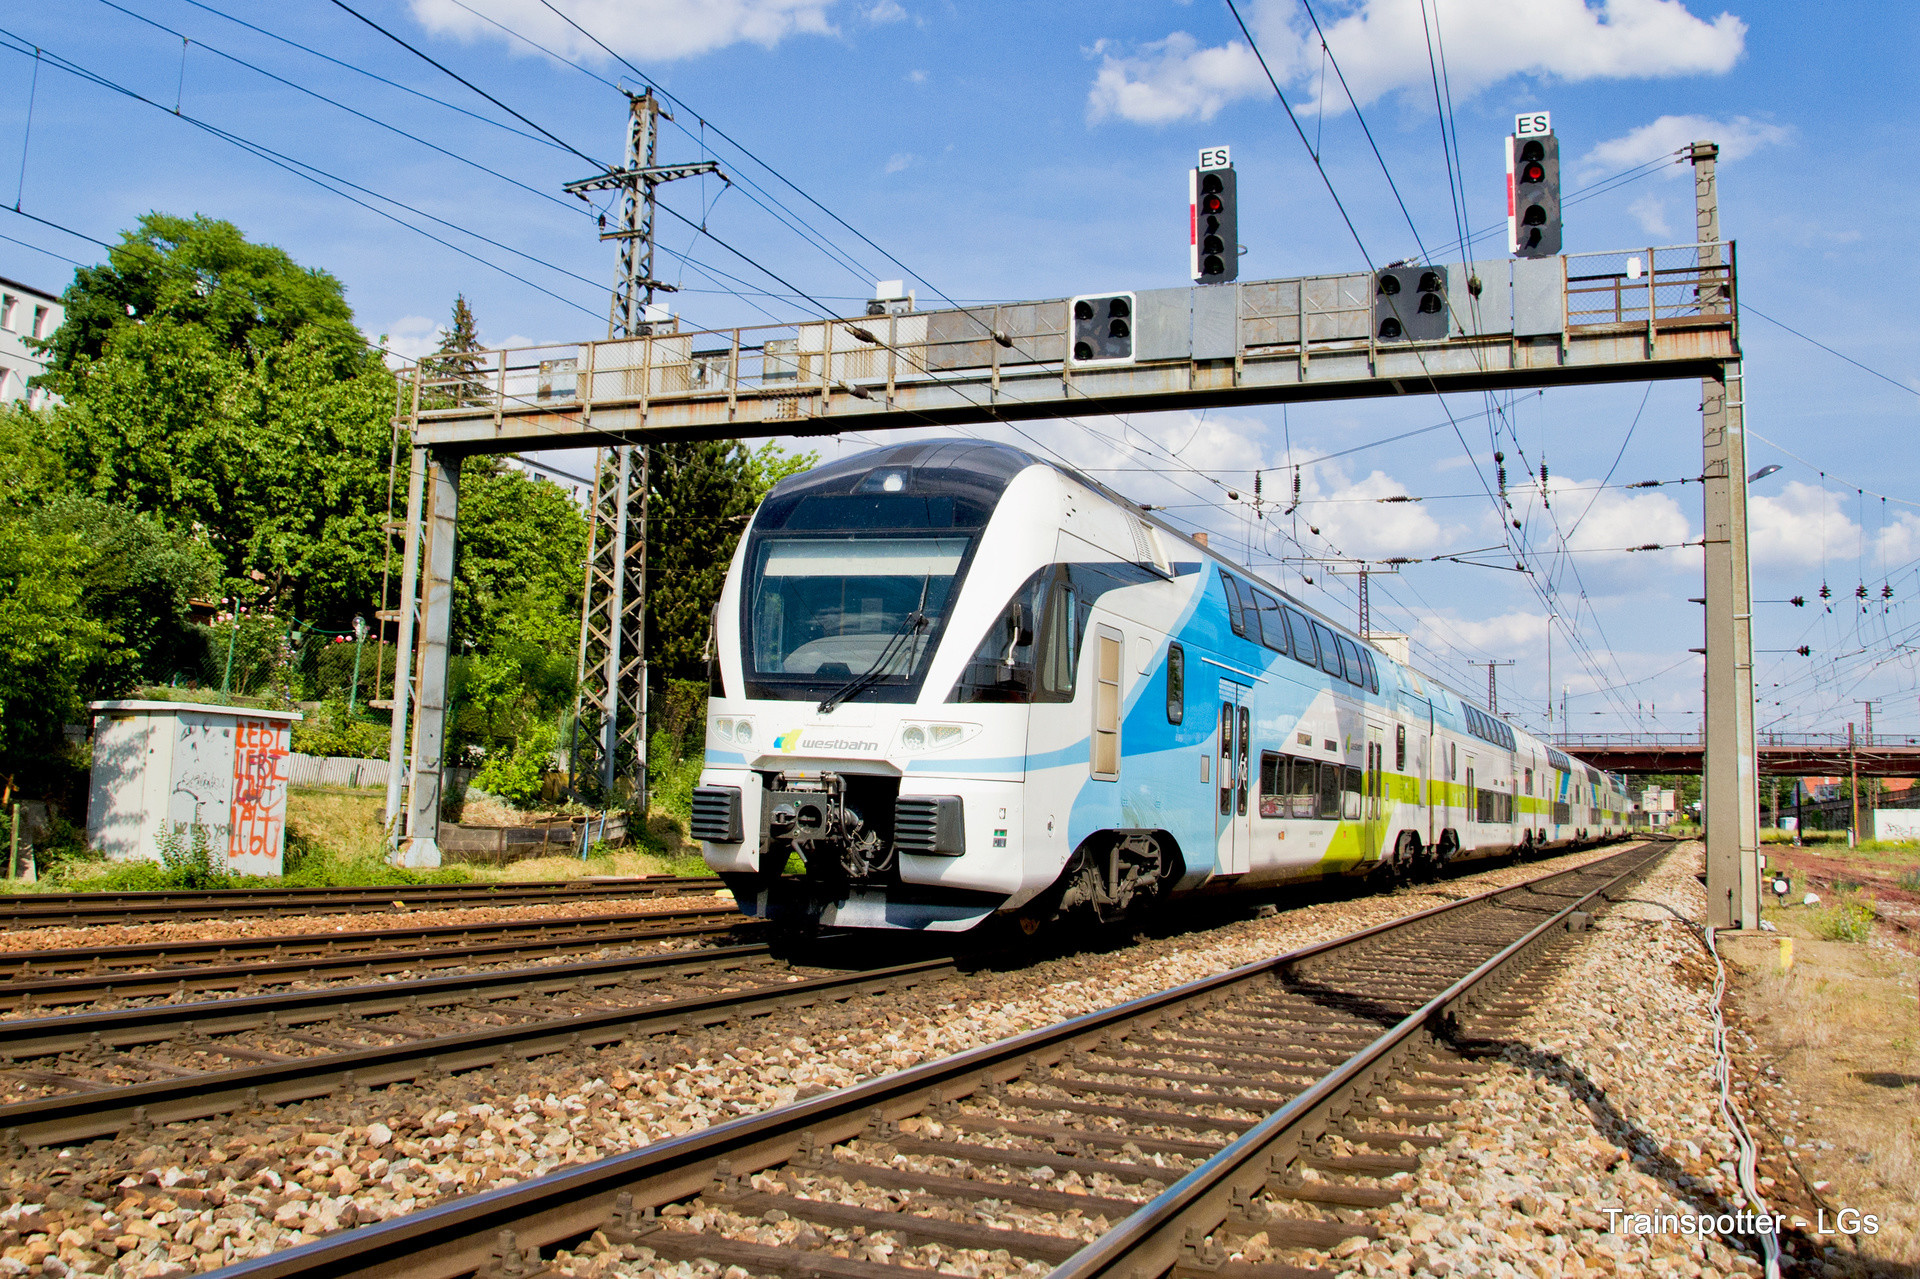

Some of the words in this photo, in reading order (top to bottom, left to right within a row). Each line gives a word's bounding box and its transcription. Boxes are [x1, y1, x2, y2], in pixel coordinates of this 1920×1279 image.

[1518, 115, 1547, 134] ES
[1201, 149, 1227, 168] ES
[802, 739, 879, 751] westbahn
